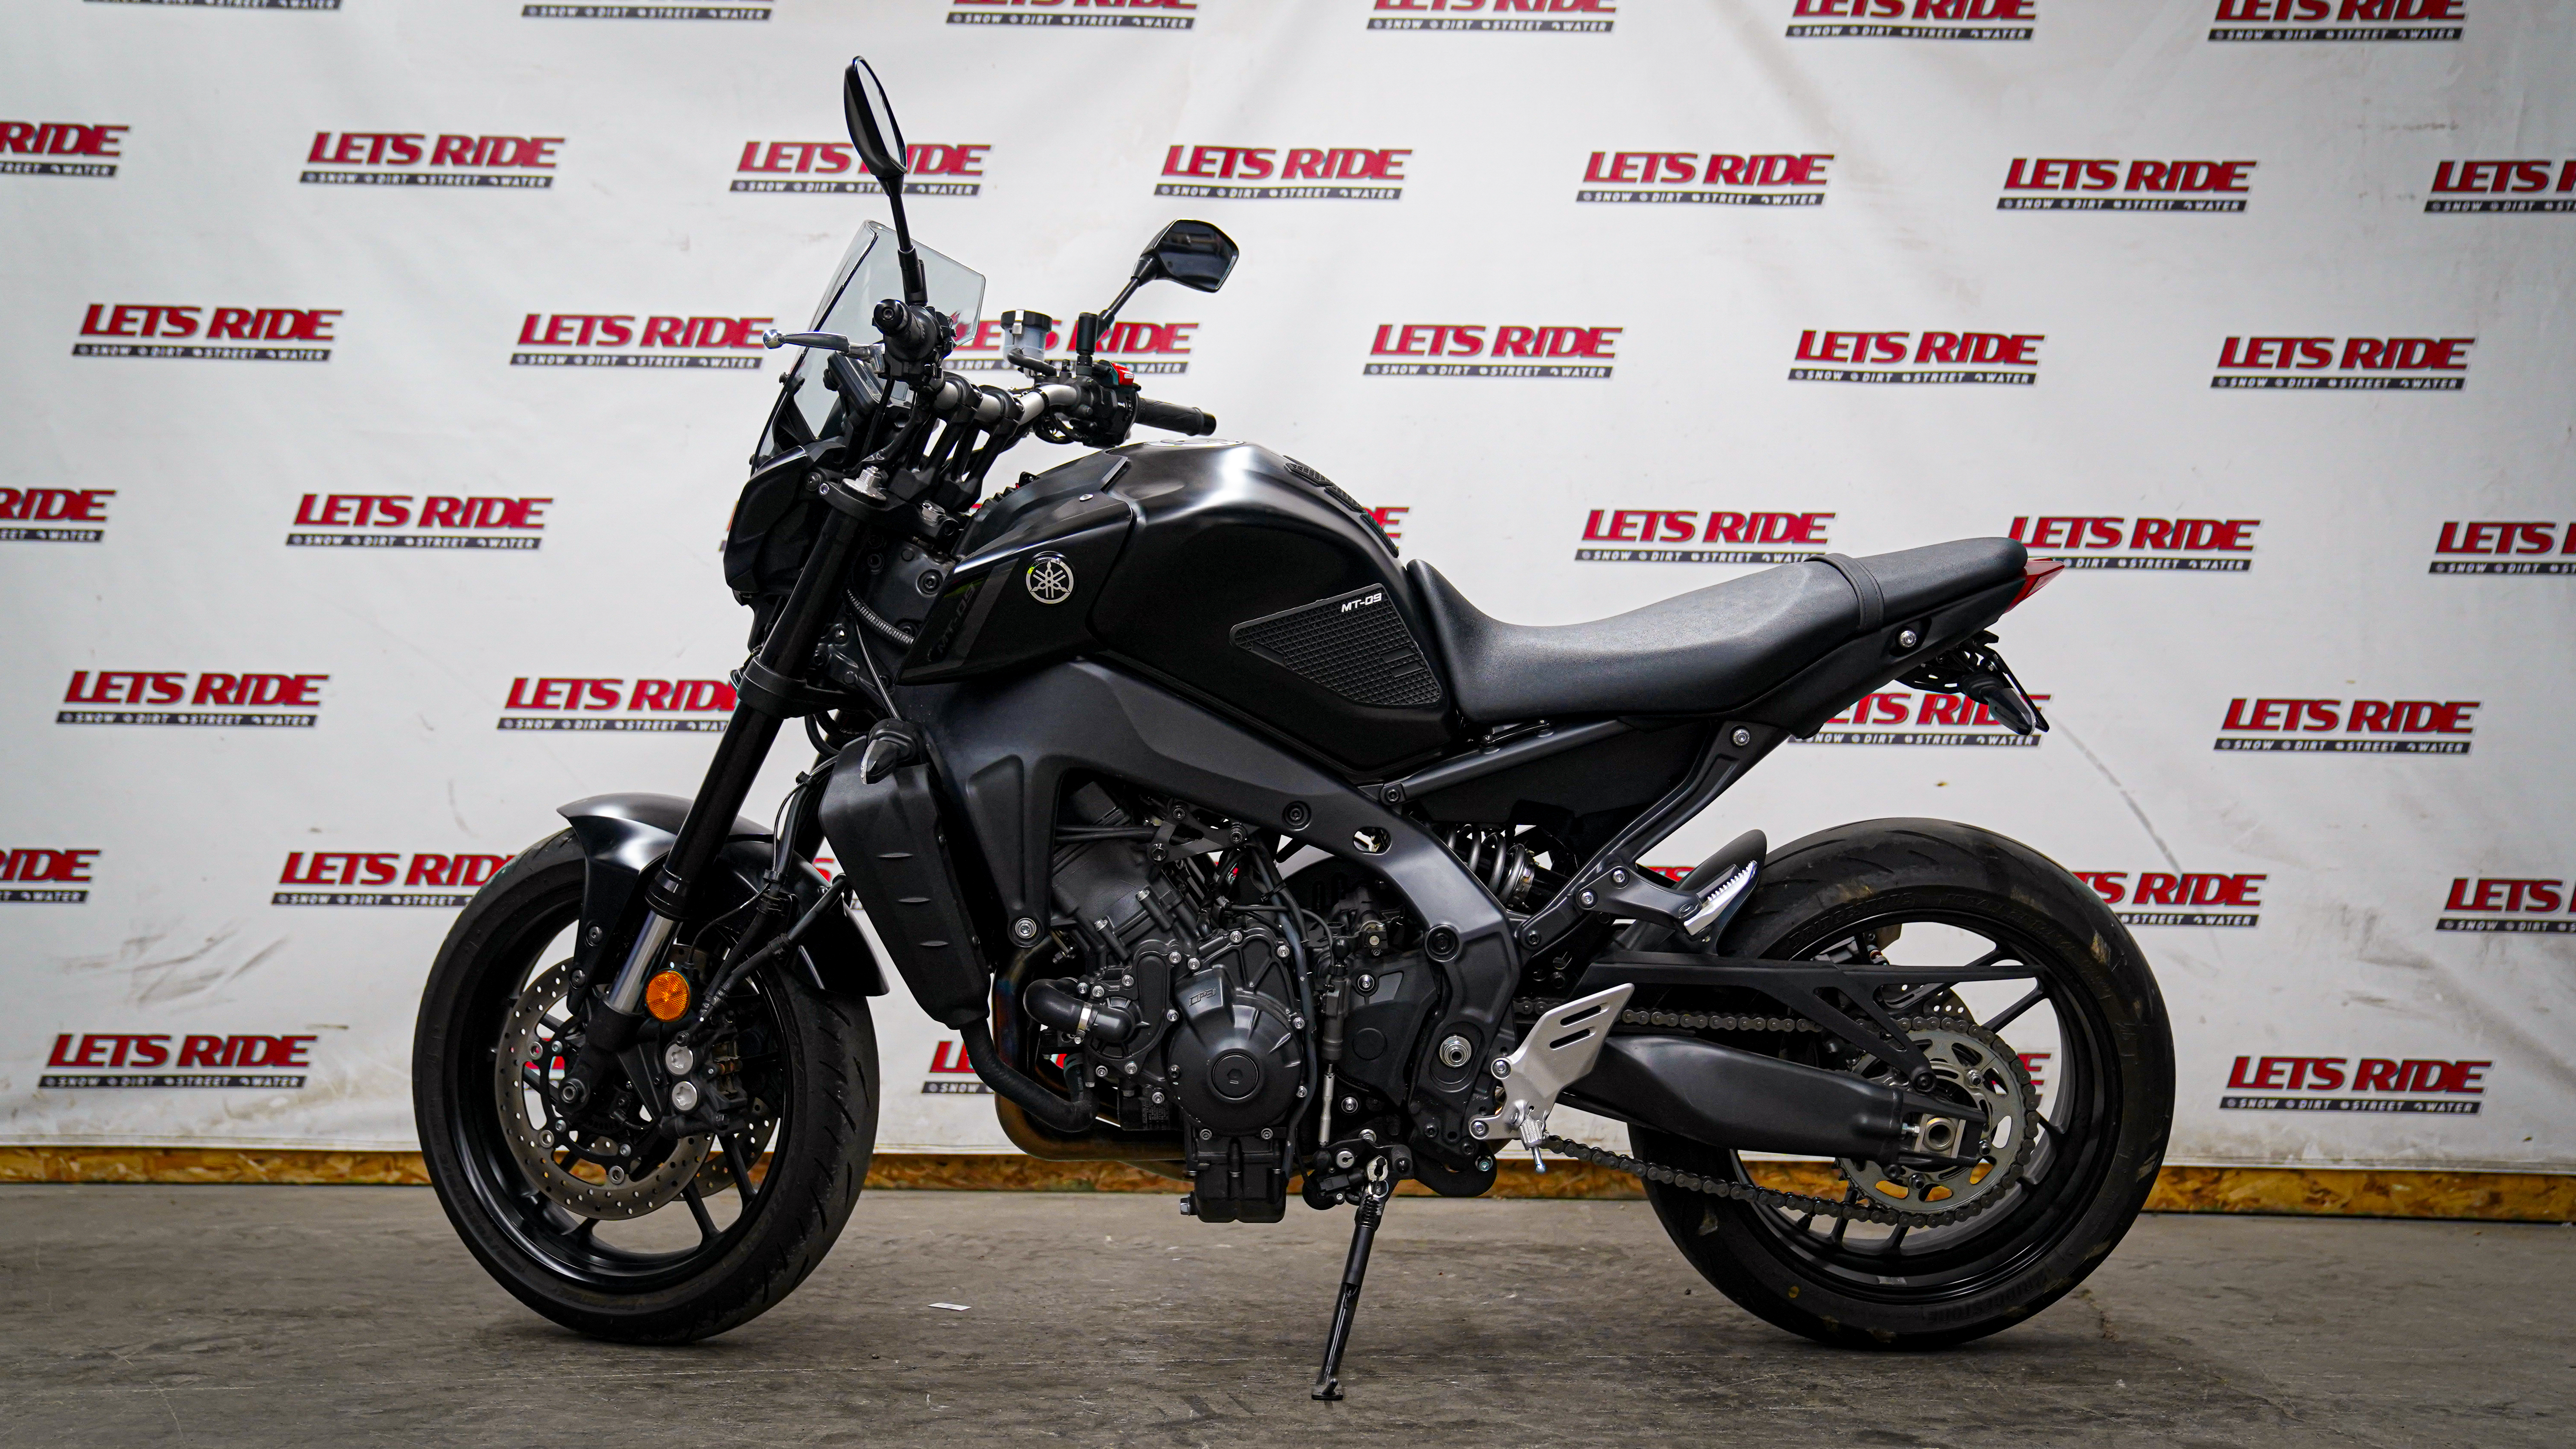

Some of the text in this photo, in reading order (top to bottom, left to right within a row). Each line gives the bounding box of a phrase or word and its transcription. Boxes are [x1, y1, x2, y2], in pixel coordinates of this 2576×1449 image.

[964, 14, 1188, 28] SNOW DIRT STREET WATER
[1385, 19, 1607, 31] SNOW DIRT STREET WATER
[2217, 0, 2463, 21] LETS RIDE
[1804, 26, 2026, 40] SNOW DIRT STREET WATER
[2226, 29, 2455, 40] SNOW DIRT STREET WATER
[0, 122, 129, 156] RIDE
[307, 132, 563, 168] LETS RIDE
[738, 141, 992, 175] LETS IDE
[1162, 146, 1412, 180] LETS RIDE
[1584, 152, 1833, 186] LETS RIDE
[748, 182, 973, 195] SNOW DIRT STRT WATER
[2005, 158, 2255, 192] LETS RIDE
[2433, 161, 2549, 192] LETS
[1172, 186, 1395, 199] SNOW DIRT STREET WATER
[1594, 192, 1817, 205] SNOW DIRT STREET WATER
[2015, 199, 2240, 211] SNOW DIRT STREET WATER
[81, 304, 342, 341] LETS RIDE
[518, 314, 774, 349] LETS RIDE
[954, 320, 1062, 351] LE
[1370, 324, 1622, 359] LETS RIDE
[1795, 330, 2044, 365] LETS RIDE
[2218, 337, 2472, 369] LETS RIDE
[529, 355, 756, 368] SNOW DIRT STREET WATER
[957, 360, 1182, 374] SNOW WATER
[1381, 365, 1606, 377] SNOW DIRT STREET WATER
[1806, 371, 2030, 384] SNOW DIRT STREET WATER
[2229, 377, 2458, 390] SNOW DIRT STREET WATER
[295, 494, 552, 529] LETS RIDE
[1583, 510, 1835, 544] LETS RIDE
[2007, 517, 2260, 551] LETS RIDE
[2437, 522, 2554, 554] LETS
[1593, 551, 1818, 563] SNOW DIRT STREET WATE
[2076, 557, 2245, 570] DIRT STREET WATER
[2447, 563, 2541, 574] SNOW DIRT
[1341, 593, 1382, 612] MT-09
[65, 671, 328, 706] LETS RIDE
[505, 677, 623, 711] LETS
[1826, 693, 1912, 725] TS
[2223, 698, 2479, 734] LETS RIDE
[516, 719, 729, 731] SNOW DIRT STREET WAT
[1863, 733, 1896, 743] DIRT
[1916, 735, 1967, 745] STREET
[1989, 734, 2034, 743] WATER
[2234, 740, 2464, 753] SNOW DIRT STREET WATER
[0, 849, 101, 882] IDE
[280, 852, 517, 886] LETS RID
[2133, 872, 2266, 907] RIDE
[2446, 879, 2560, 912] LETS
[2132, 914, 2251, 926] STREET WATER
[2457, 921, 2550, 931] SNOW DIRT
[48, 1034, 317, 1067] LETS RIDE
[939, 1084, 979, 1094] SNOW
[2227, 1056, 2490, 1093] LETS RIDE
[2238, 1099, 2473, 1113] SNOW DIRT STREET WATER
